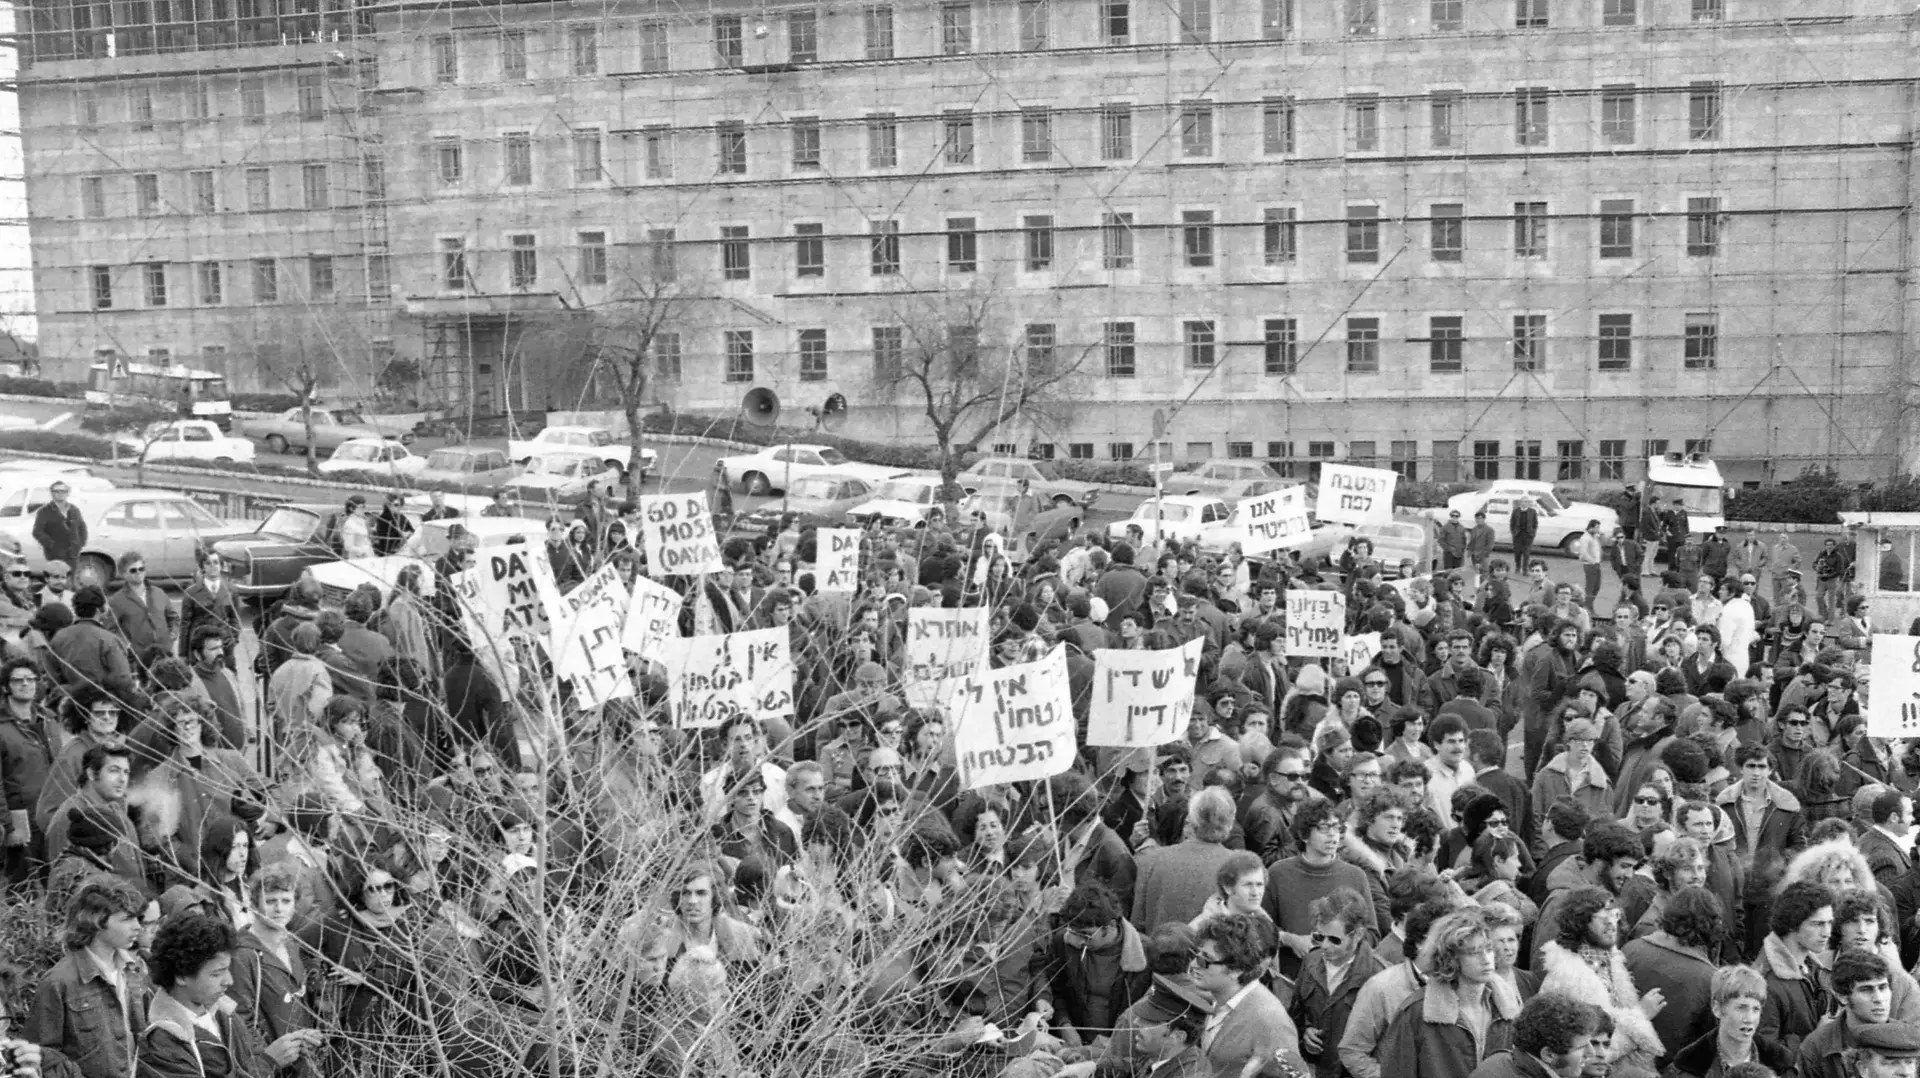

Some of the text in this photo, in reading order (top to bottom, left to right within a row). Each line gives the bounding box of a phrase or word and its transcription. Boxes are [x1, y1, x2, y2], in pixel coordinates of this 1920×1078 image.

[747, 642, 779, 680] אין
[958, 673, 1027, 715] אין לי
[1107, 667, 1174, 703] יש דין
